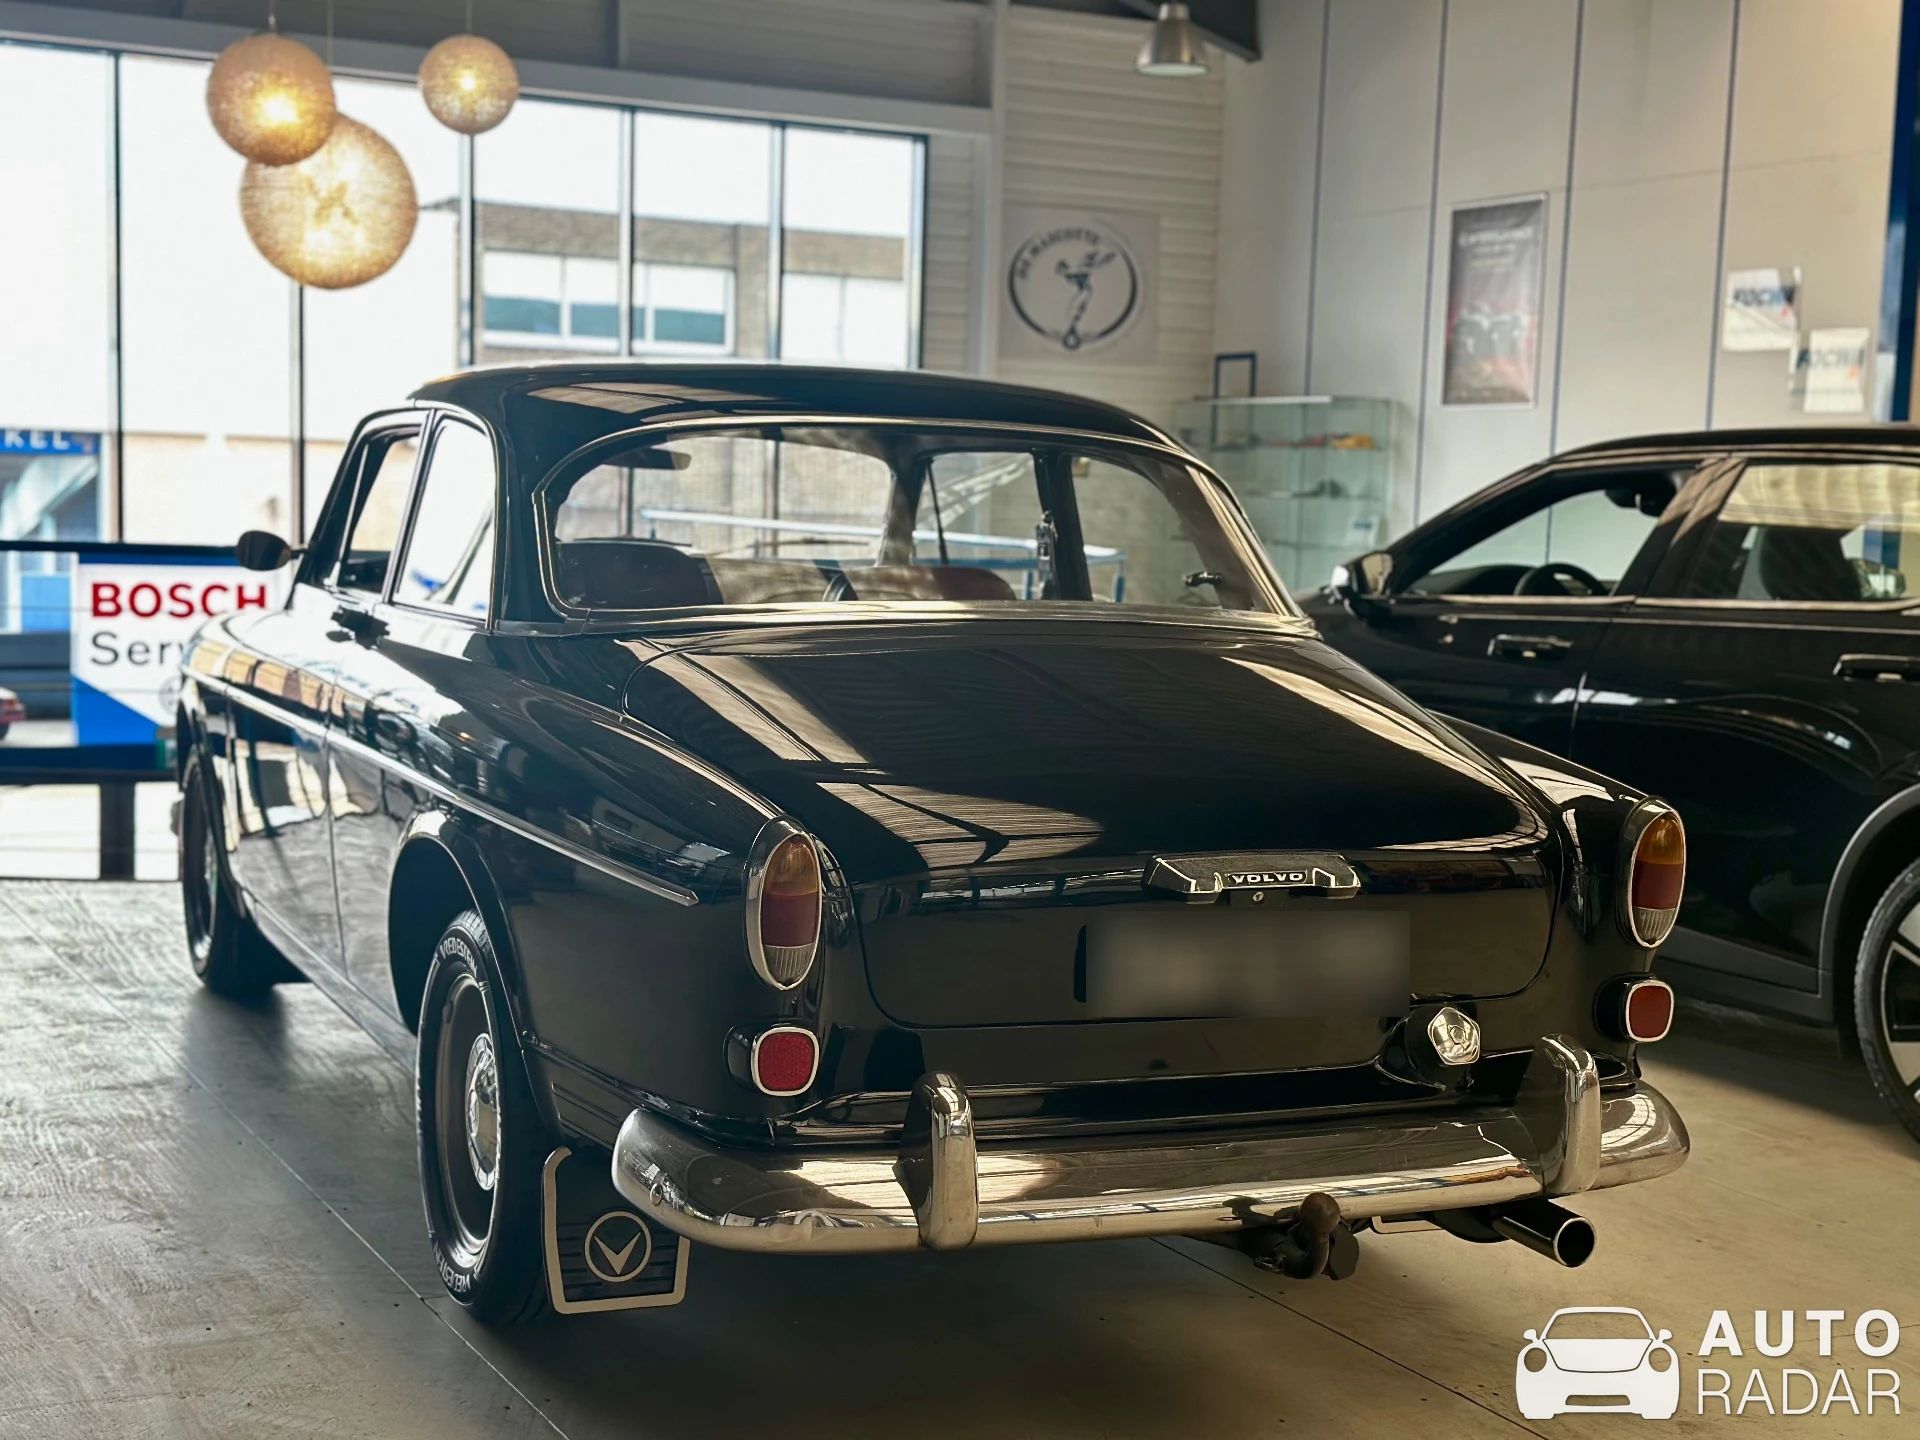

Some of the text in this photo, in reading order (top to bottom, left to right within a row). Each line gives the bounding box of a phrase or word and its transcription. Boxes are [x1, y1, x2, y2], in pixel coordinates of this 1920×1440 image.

[91, 583, 266, 618] BOSCH
[1231, 872, 1304, 885] VOLVO
[439, 936, 477, 979] VREDESTEIN
